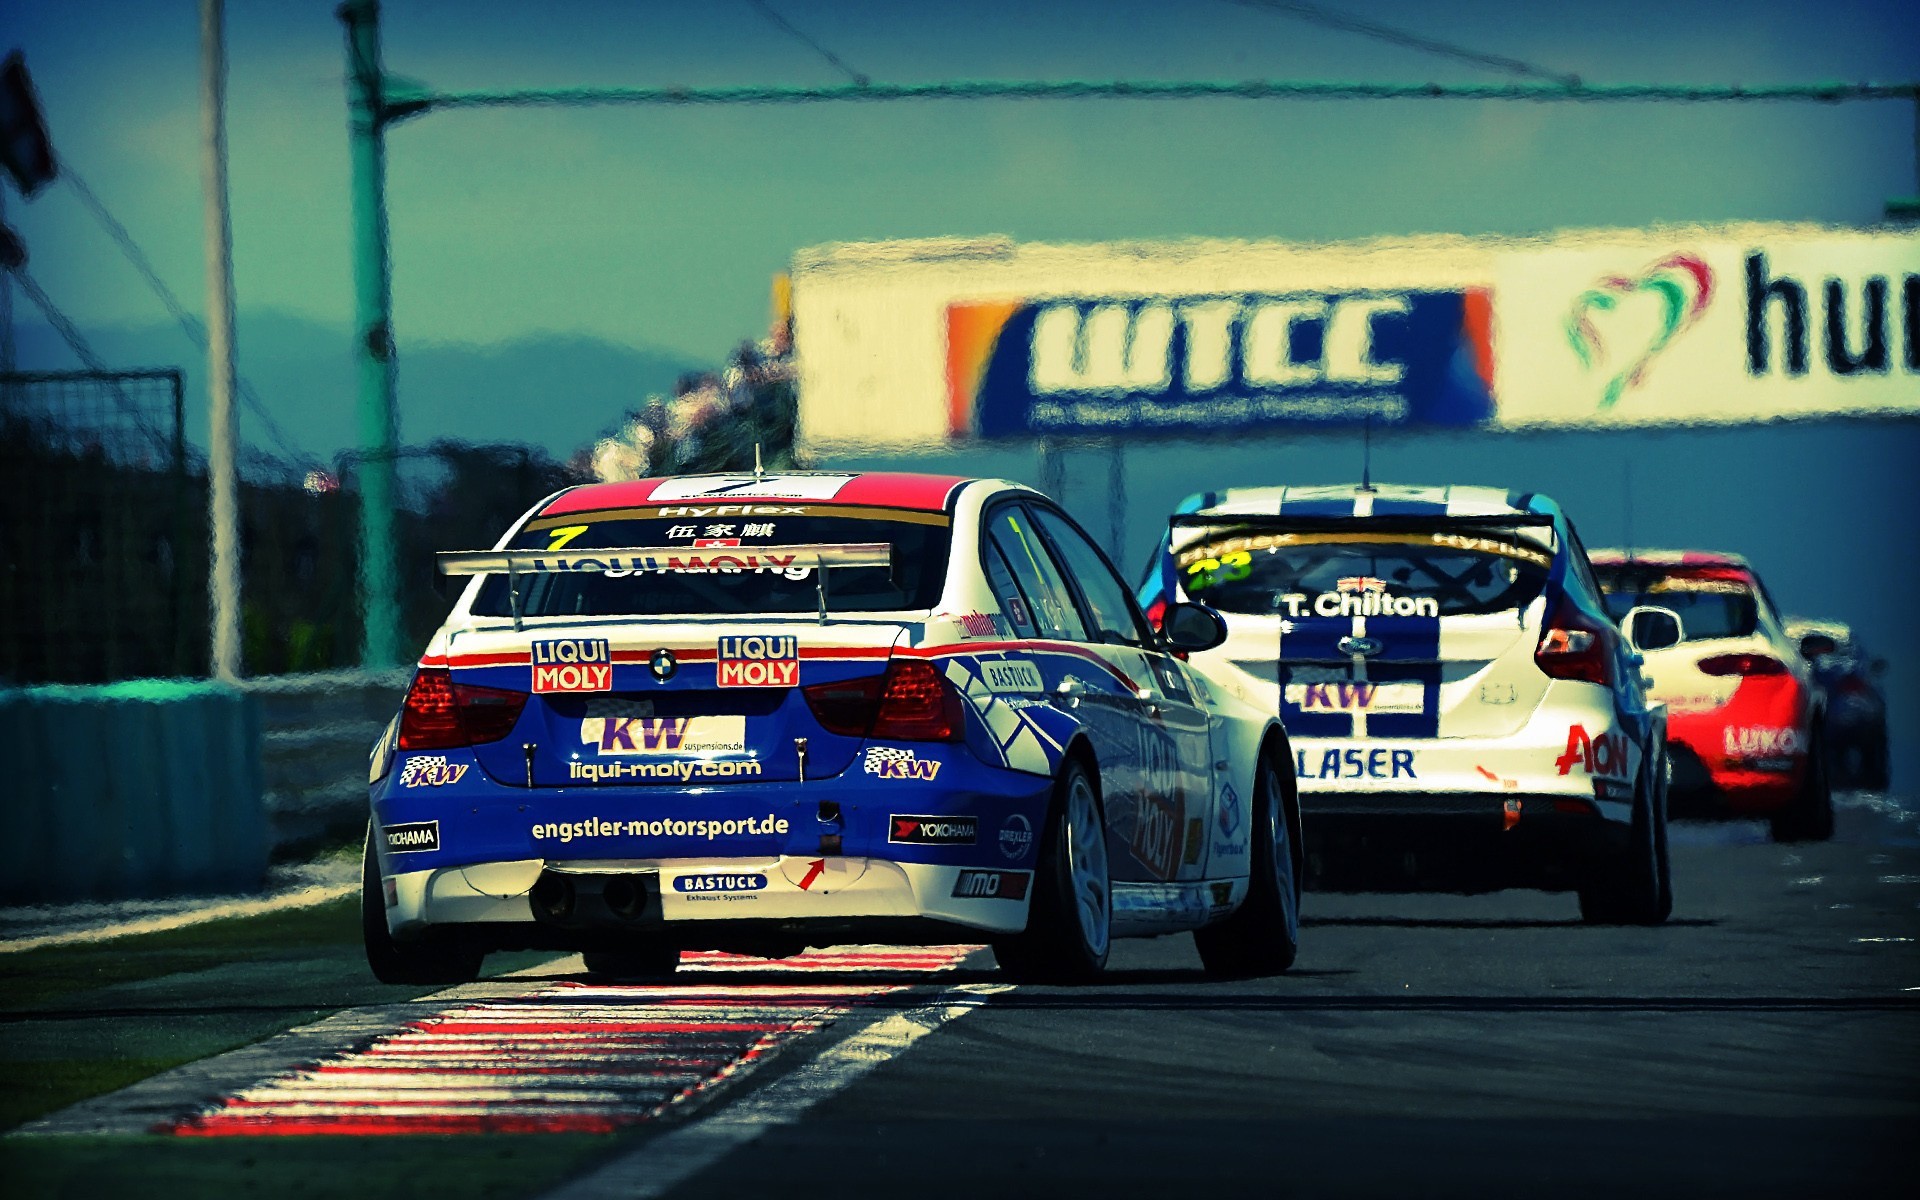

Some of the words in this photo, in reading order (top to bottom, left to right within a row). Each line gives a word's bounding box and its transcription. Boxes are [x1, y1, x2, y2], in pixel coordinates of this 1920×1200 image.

[1028, 298, 1408, 397] WTCC
[658, 504, 807, 517] HyFlex
[547, 526, 589, 551] 7
[1282, 594, 1310, 617] T.
[1314, 590, 1439, 617] Chilton
[536, 640, 607, 664] LIQUI
[721, 636, 795, 660] LIQUI
[537, 665, 610, 690] MOLY
[721, 660, 798, 686] MOLY
[989, 666, 1038, 687] BASTUCK
[1304, 683, 1378, 709] KW
[600, 716, 694, 751] KW
[683, 741, 743, 752] suspensions.de
[406, 764, 470, 788] KW
[569, 760, 762, 782] liqui-moly.com
[878, 759, 942, 781] KW
[1297, 749, 1418, 780] LASER
[532, 813, 789, 843] engstler-motorsport.de
[919, 822, 975, 838] YOKOHAMA
[684, 876, 758, 890] BASTUCK
[686, 894, 721, 902] Exhaust
[723, 894, 759, 902] Systems
